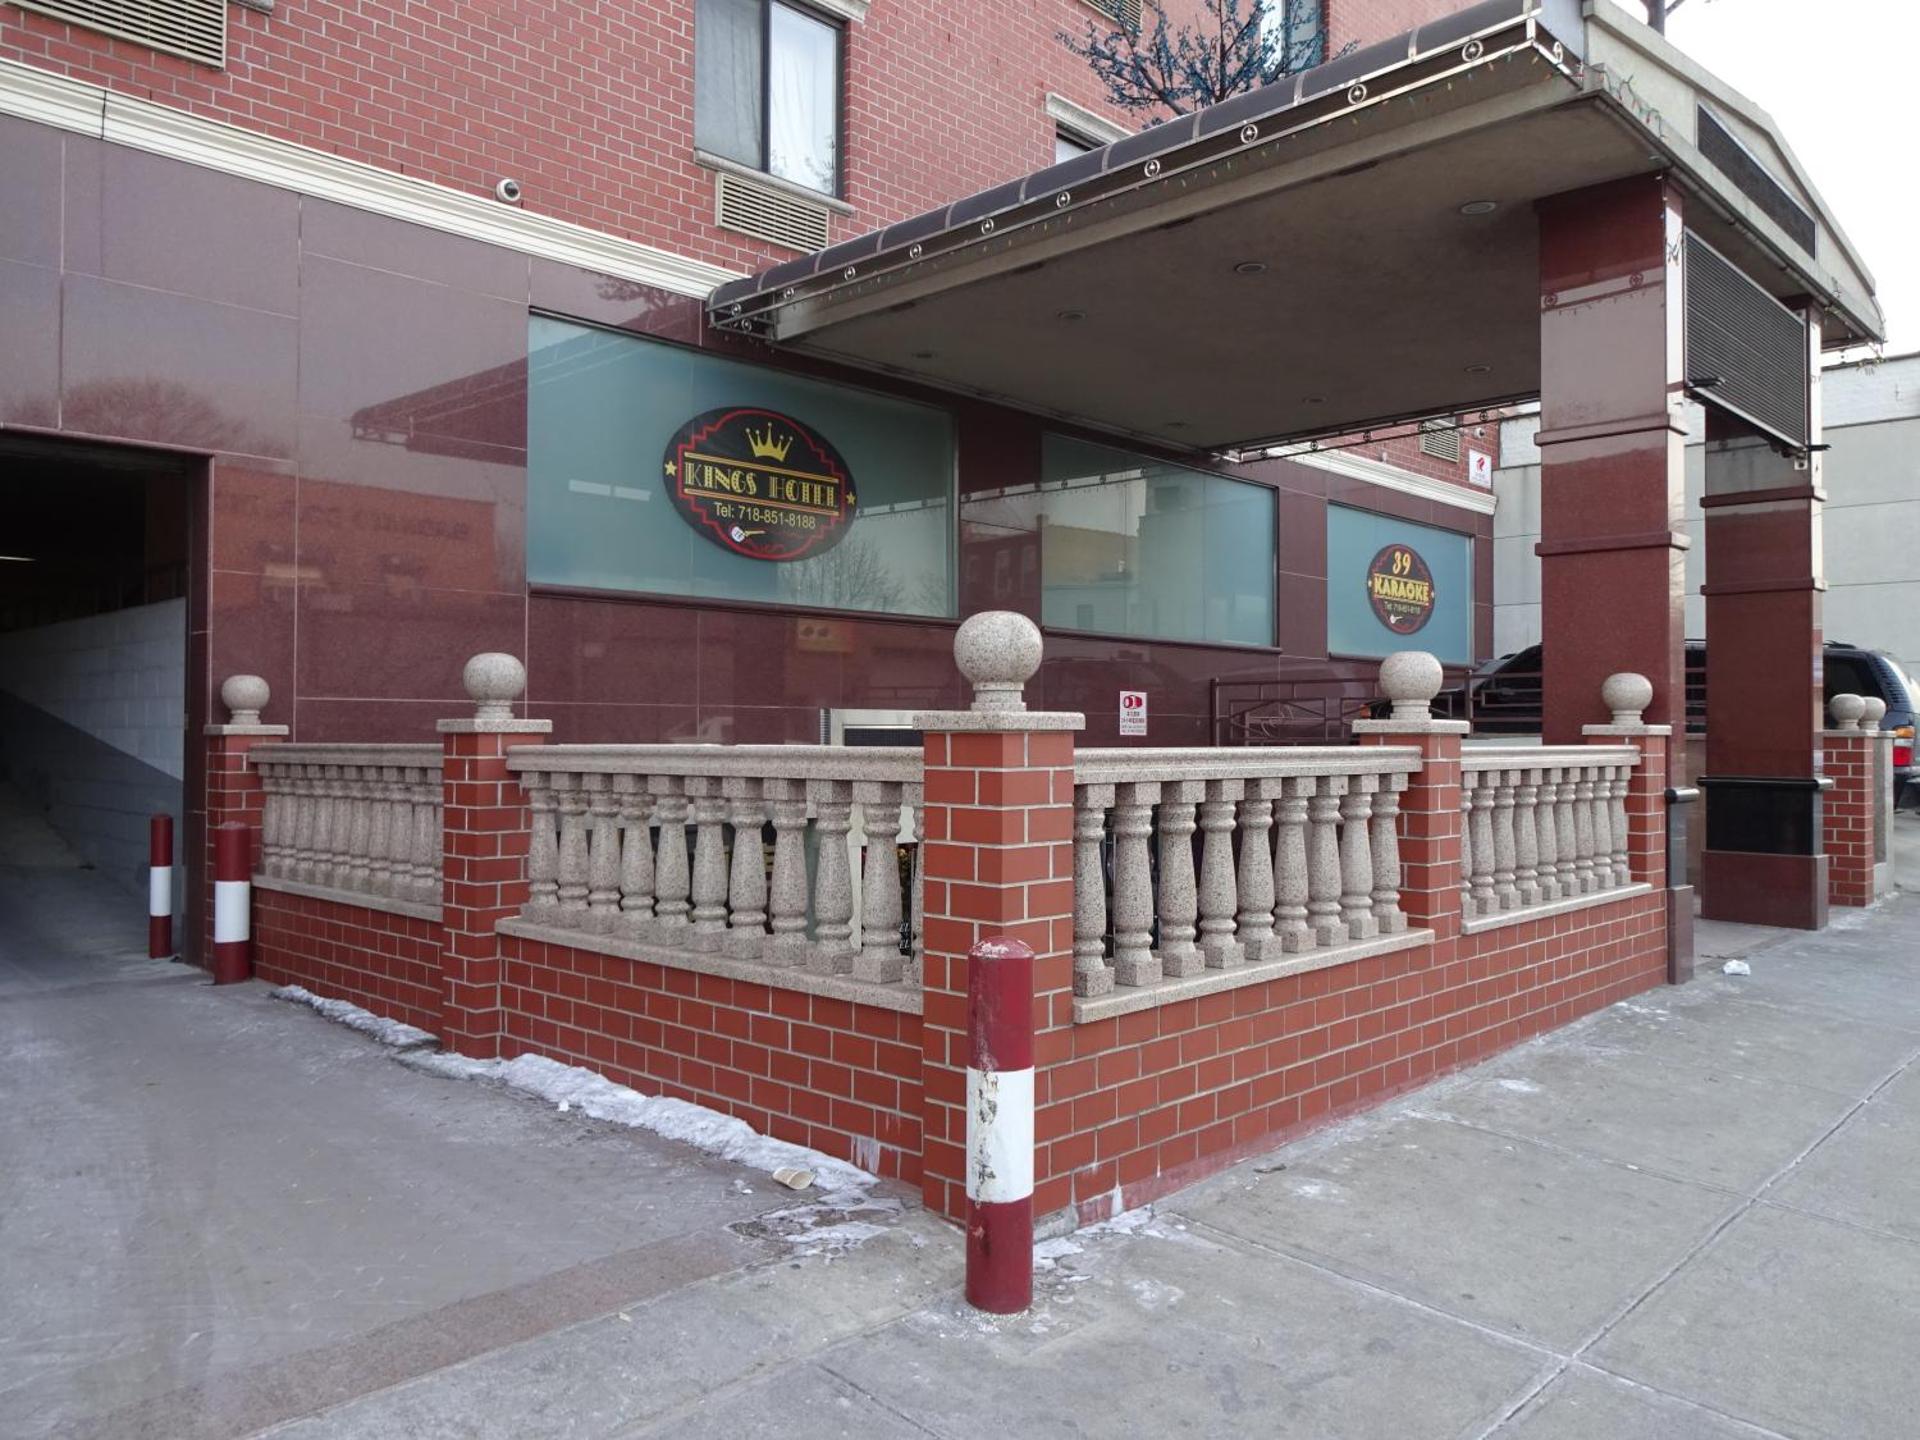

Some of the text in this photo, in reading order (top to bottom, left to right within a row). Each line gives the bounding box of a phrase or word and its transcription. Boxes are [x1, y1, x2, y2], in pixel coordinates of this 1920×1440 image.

[684, 462, 838, 508] KINGS HOTEL
[714, 502, 816, 529] Tel: 718-851-8188
[1393, 551, 1411, 575] 39
[1375, 577, 1429, 602] KARAOKE
